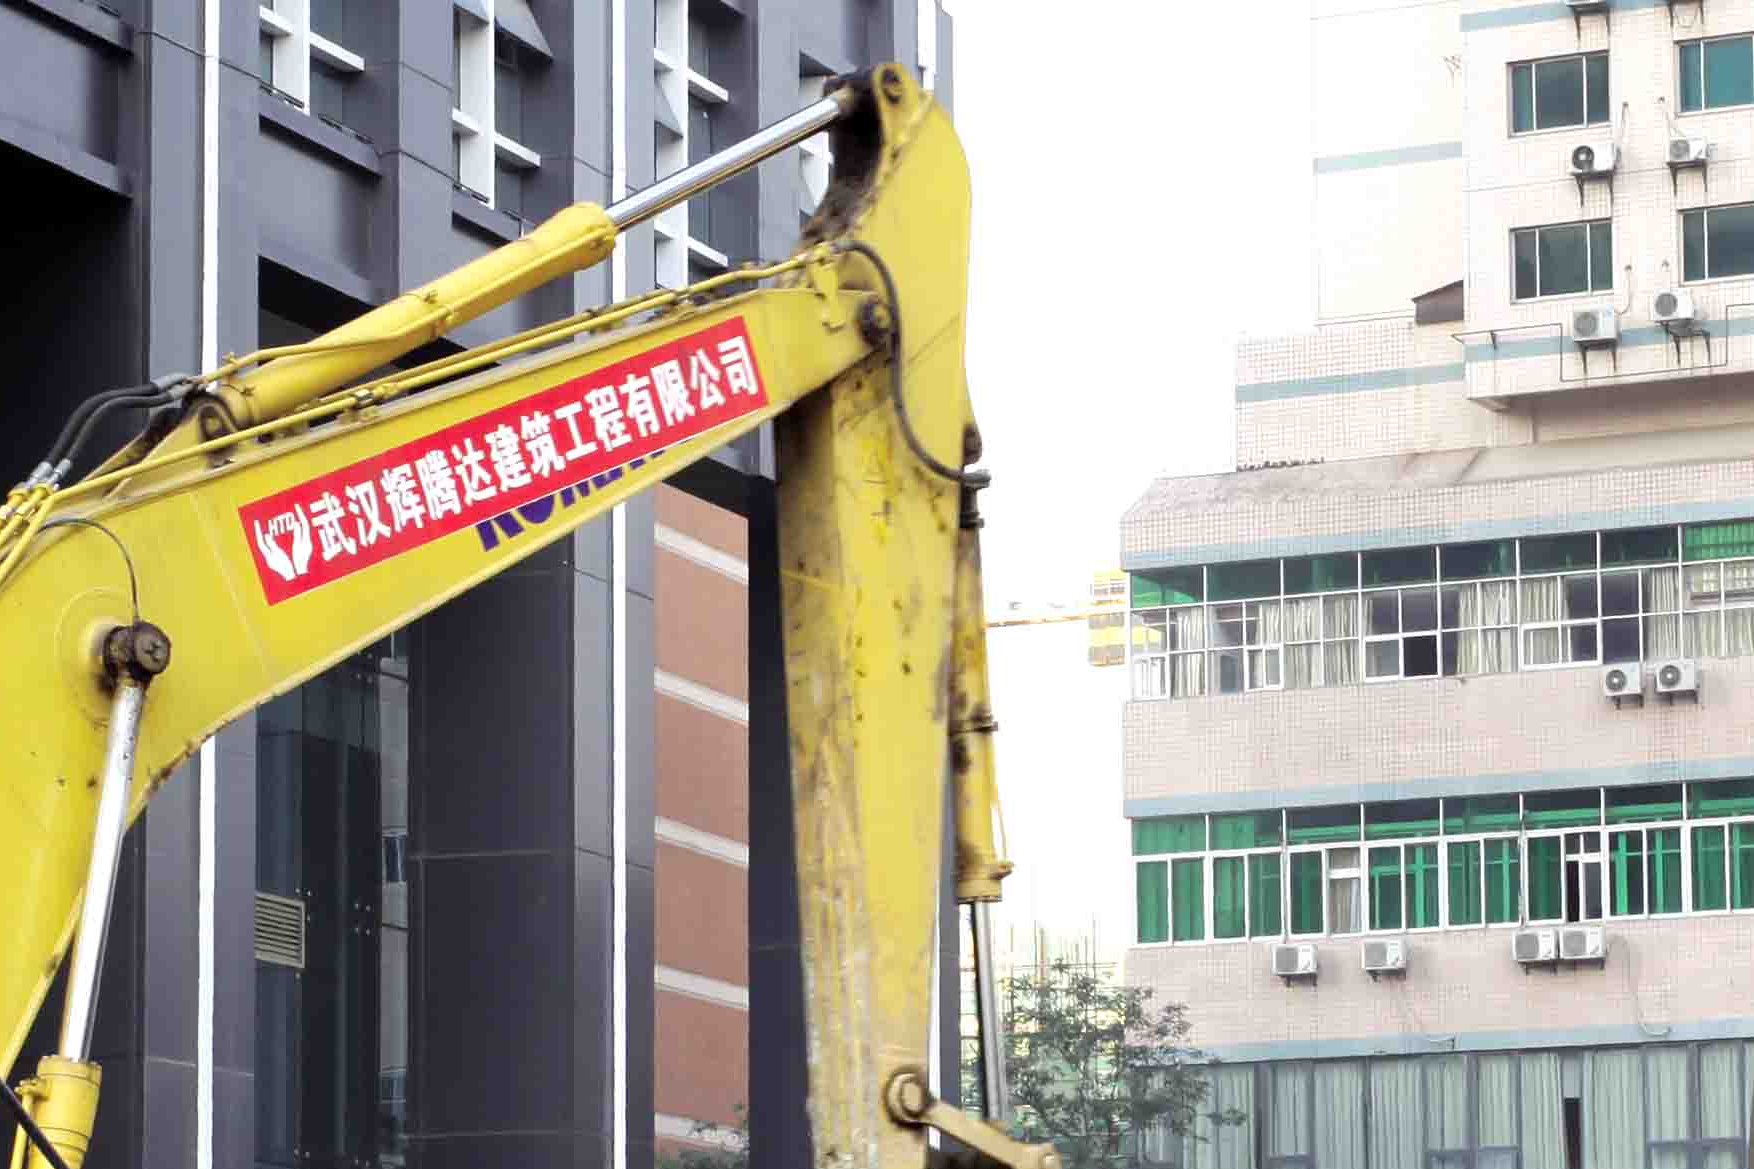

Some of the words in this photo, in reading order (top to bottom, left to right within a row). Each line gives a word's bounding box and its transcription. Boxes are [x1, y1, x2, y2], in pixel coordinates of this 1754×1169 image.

[311, 335, 760, 562] 武汉辉腾达建筑工程有限公司
